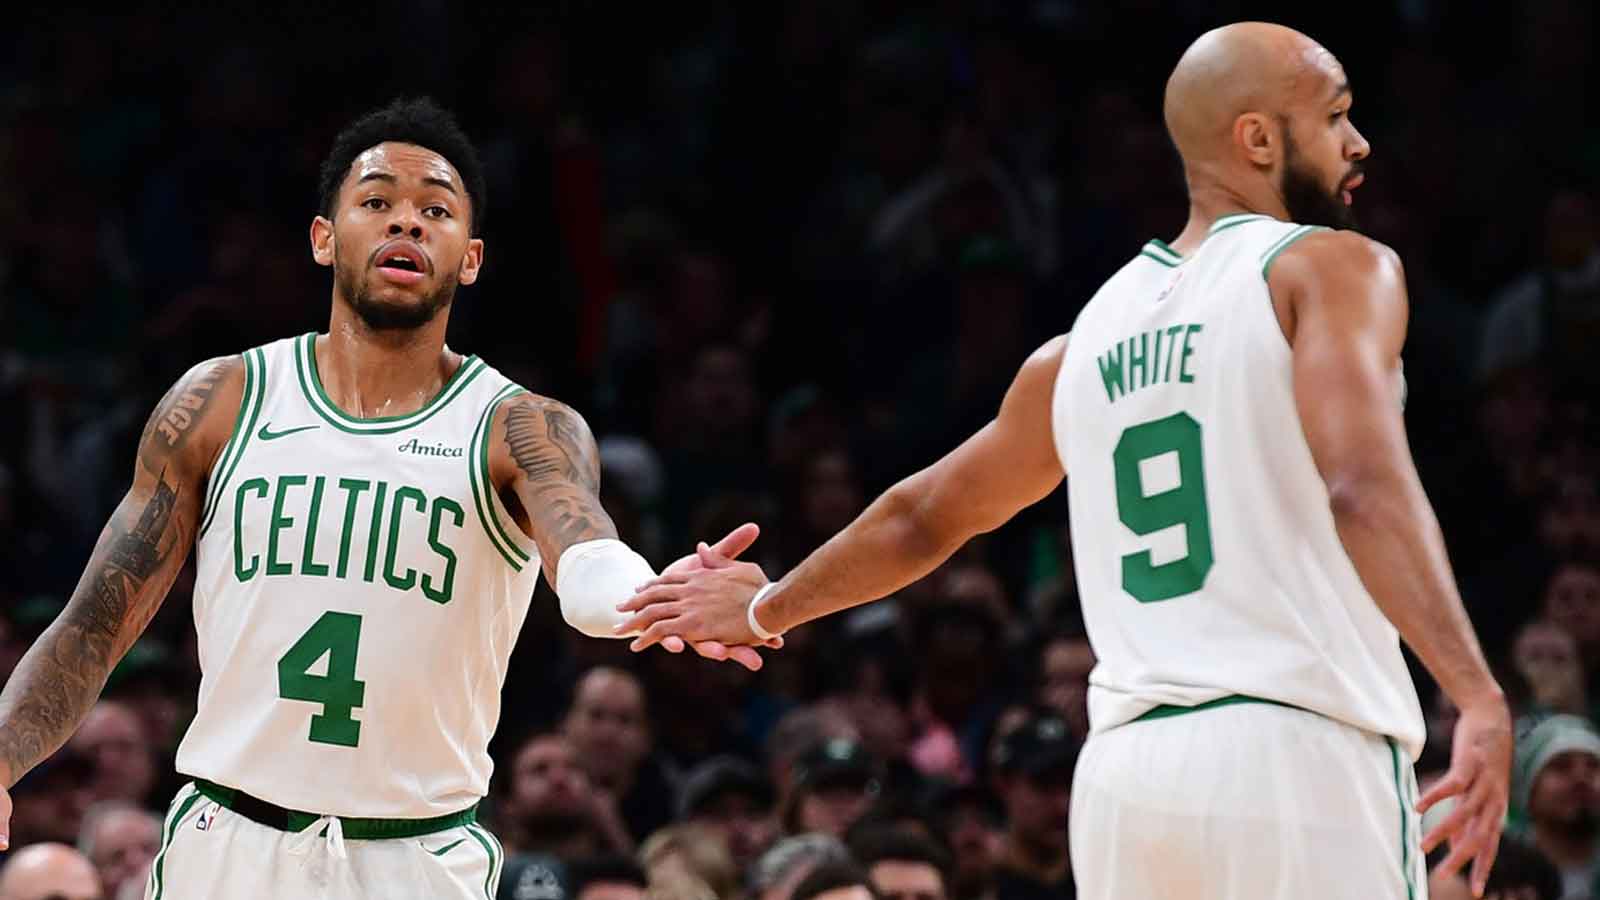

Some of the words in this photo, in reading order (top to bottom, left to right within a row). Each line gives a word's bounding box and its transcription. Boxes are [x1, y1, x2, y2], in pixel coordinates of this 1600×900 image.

[1098, 324, 1202, 402] WHITE
[398, 438, 463, 458] Amica
[1113, 411, 1214, 603] 9
[233, 475, 465, 605] CELTICS
[278, 611, 365, 747] 4
